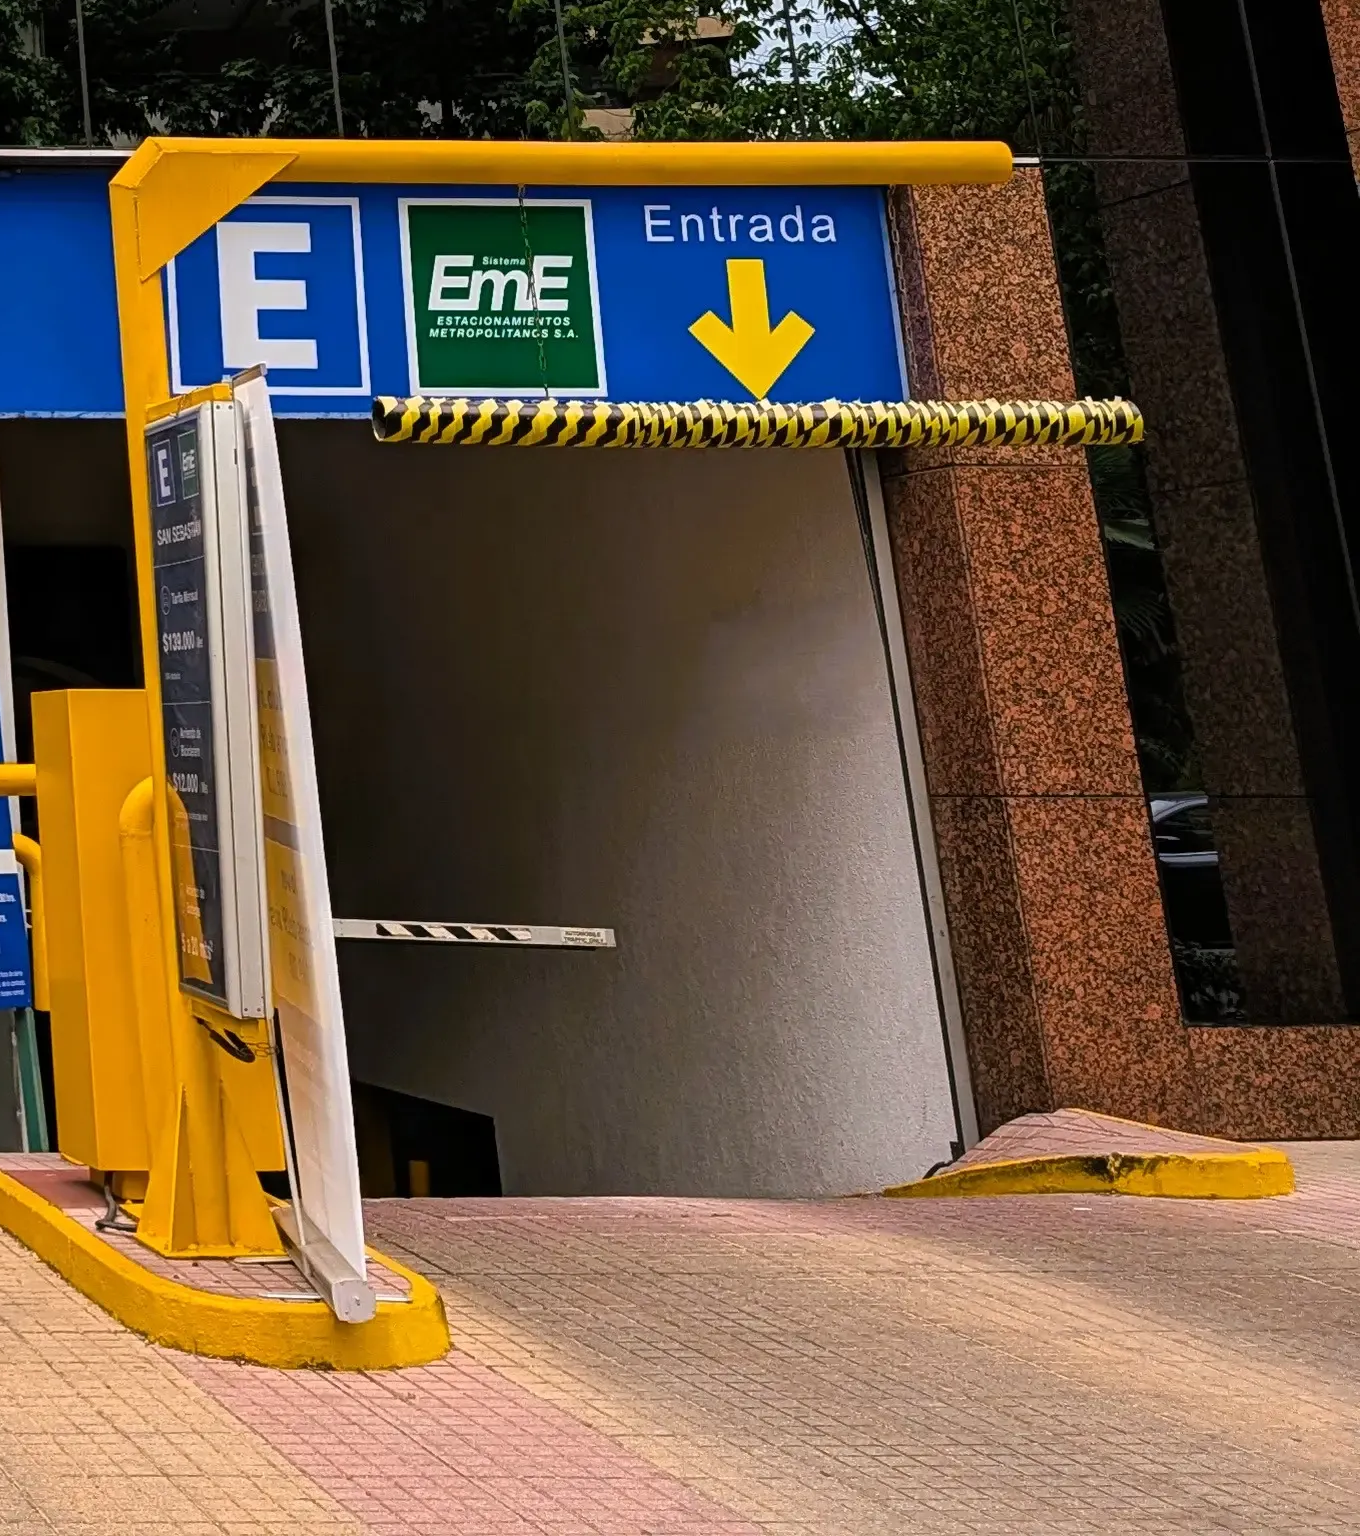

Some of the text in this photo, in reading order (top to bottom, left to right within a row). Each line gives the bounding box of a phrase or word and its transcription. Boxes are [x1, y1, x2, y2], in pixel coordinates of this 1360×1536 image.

[645, 205, 837, 243] Entrada
[482, 256, 526, 265] Sistema
[216, 222, 318, 370] E
[436, 316, 571, 326] ESTACIONAMIENTOS
[429, 328, 579, 338] METROPOLITANOS S.A.
[157, 449, 171, 498] E
[157, 527, 171, 546] SAN
